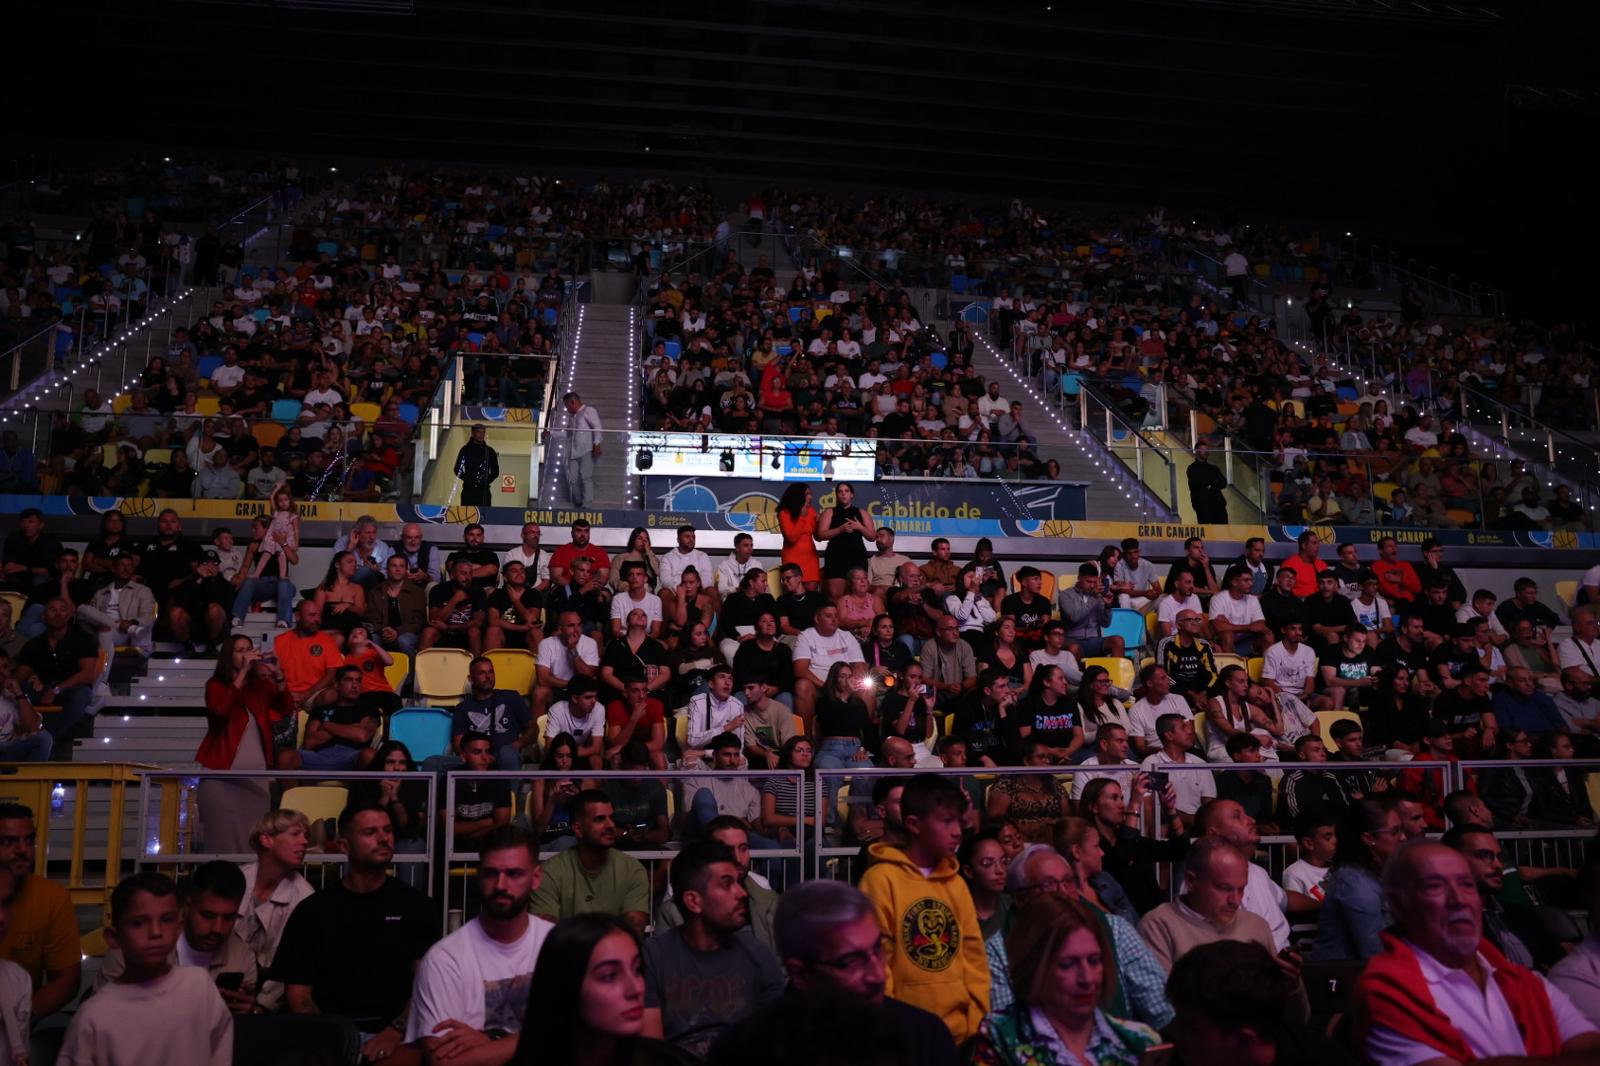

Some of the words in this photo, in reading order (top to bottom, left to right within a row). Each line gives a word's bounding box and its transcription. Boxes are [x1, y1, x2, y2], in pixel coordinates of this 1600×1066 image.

[235, 502, 265, 517] GRAN
[866, 499, 950, 519] Cabildo
[954, 501, 982, 520] de
[524, 510, 553, 524] GRAN
[1138, 525, 1162, 537] GRAN
[1166, 526, 1206, 538] CANARIA
[1328, 979, 1338, 992] 7
